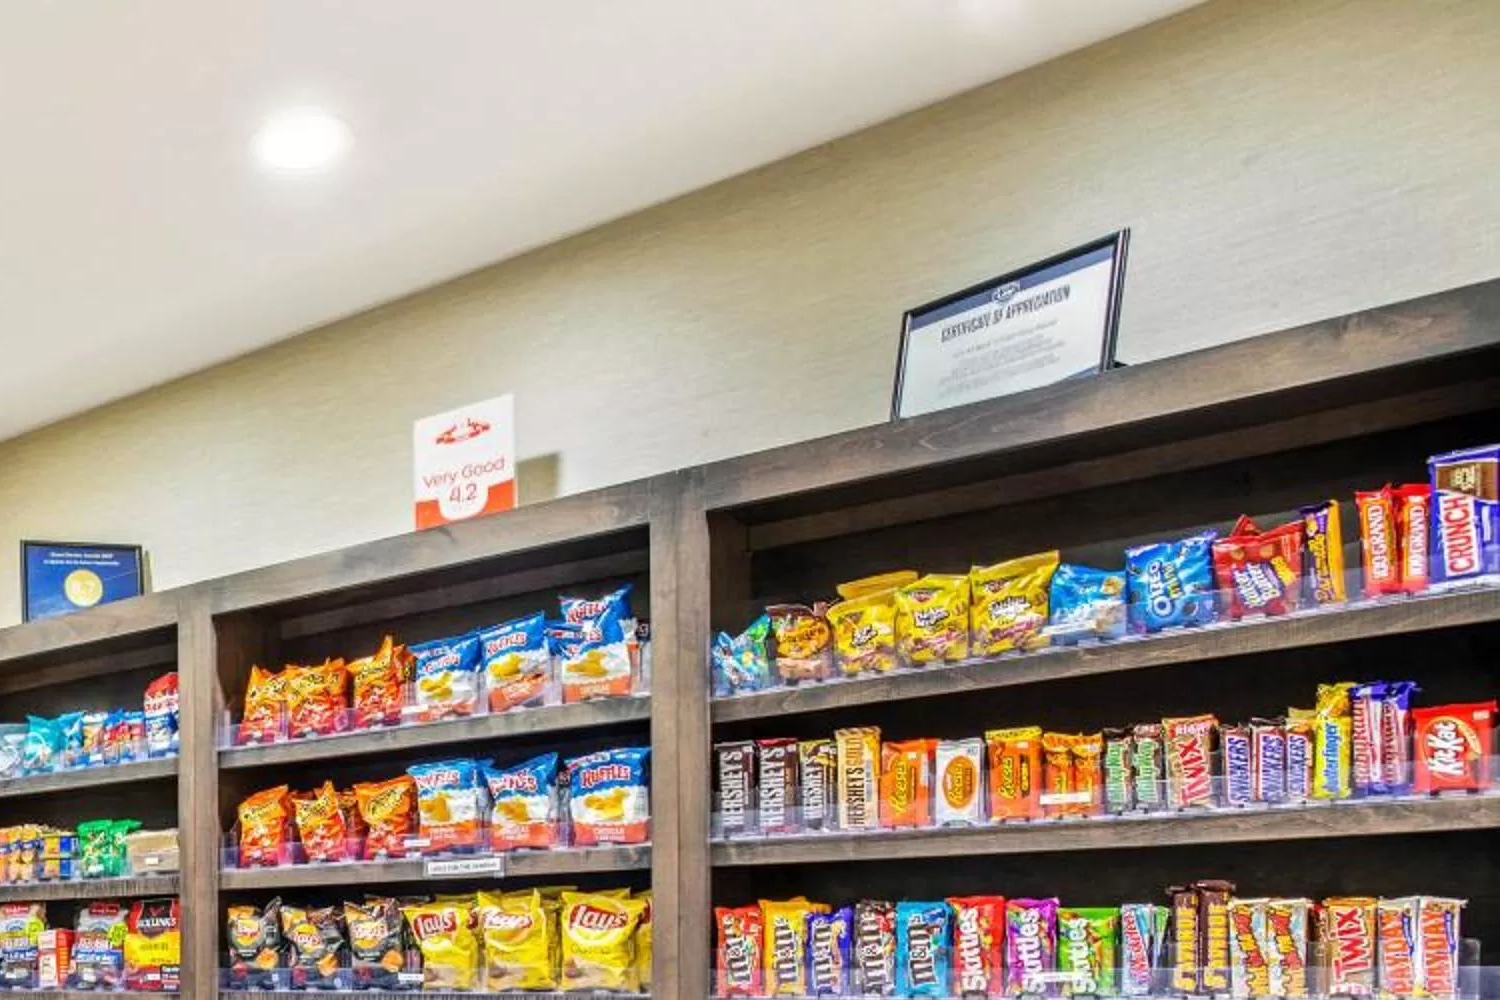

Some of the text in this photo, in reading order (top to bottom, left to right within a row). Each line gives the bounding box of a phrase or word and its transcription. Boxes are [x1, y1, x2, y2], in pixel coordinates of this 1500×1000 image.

[940, 313, 992, 343] CERTIFICATE
[992, 309, 1004, 327] OF
[1005, 284, 1072, 320] APPRECIATION
[422, 456, 506, 490] Very Good
[448, 483, 478, 503] 4.2
[1443, 495, 1476, 576] CRUNCH
[720, 751, 744, 826] HERSHEY'S
[759, 747, 785, 827] HERSHEY'S
[1228, 736, 1250, 803] SNICKERS
[959, 907, 988, 991] Skittles
[1017, 907, 1047, 993] Skittles
